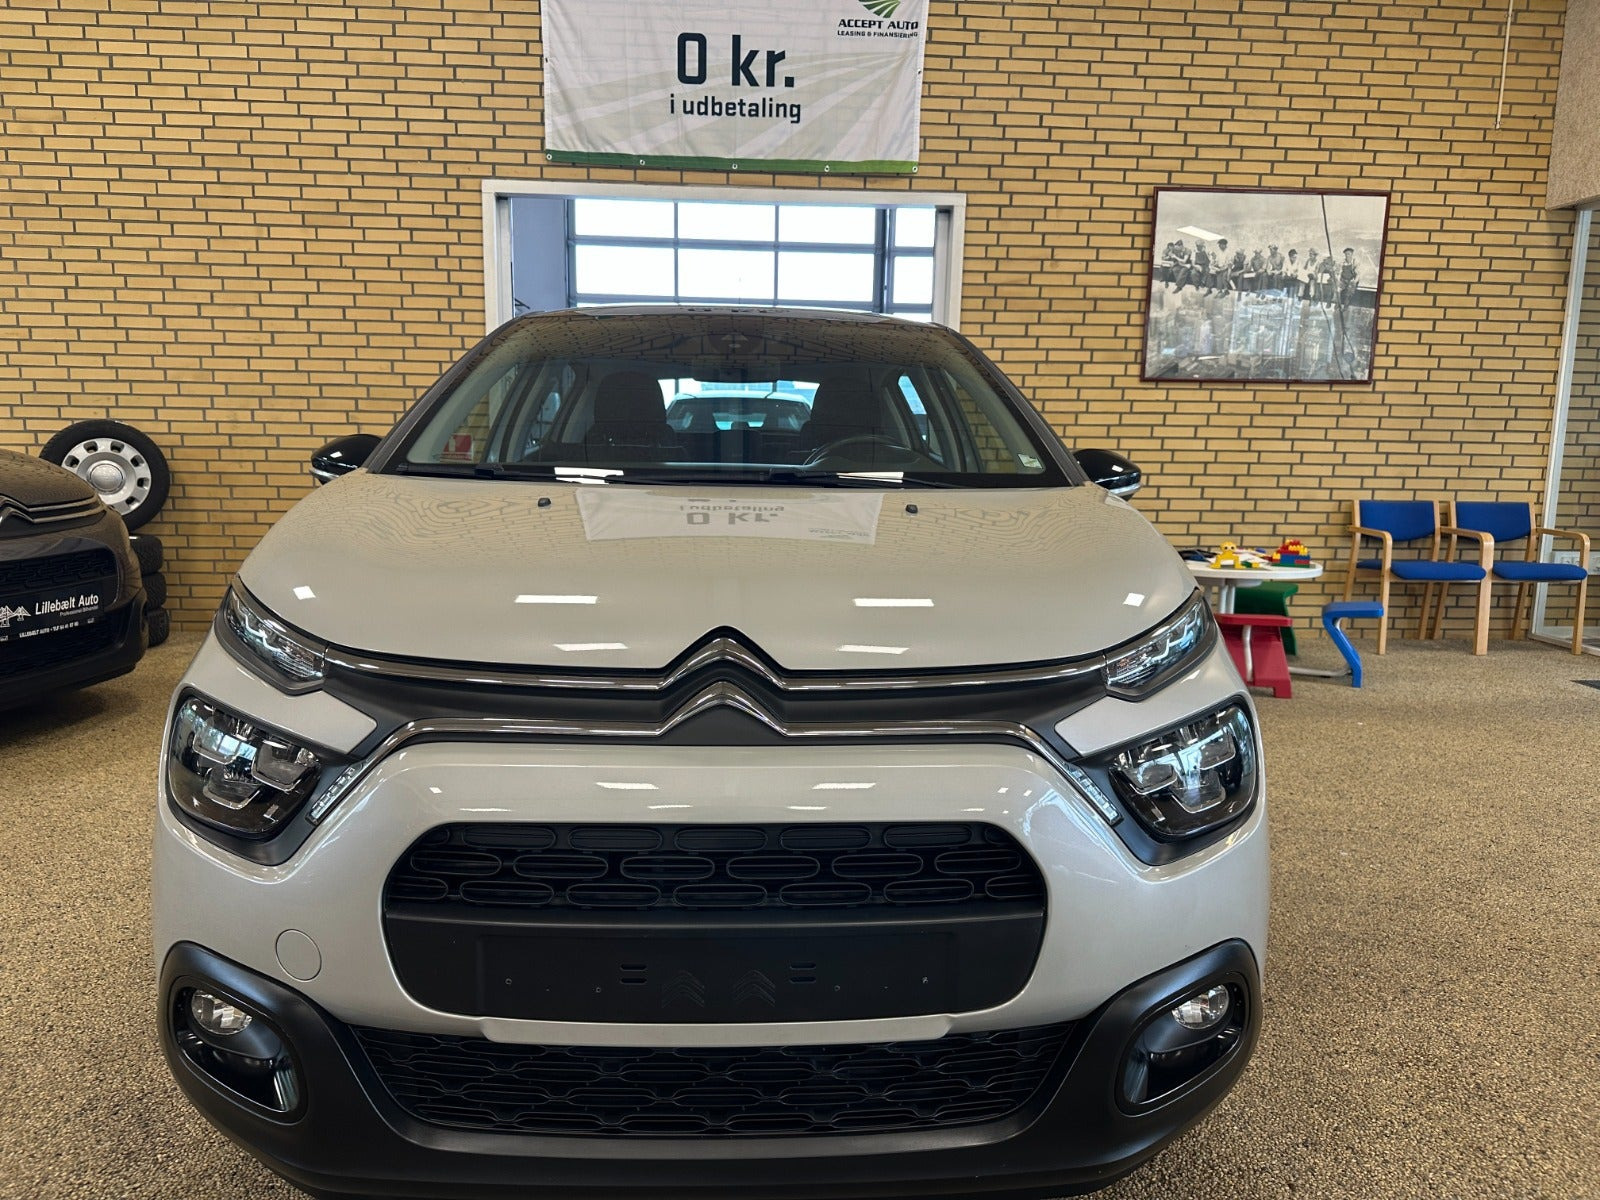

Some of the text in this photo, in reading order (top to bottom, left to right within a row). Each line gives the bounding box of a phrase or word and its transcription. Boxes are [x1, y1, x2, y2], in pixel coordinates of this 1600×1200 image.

[838, 19, 919, 30] ACCEPT AUTO
[873, 31, 918, 39] FINANSIERING
[731, 34, 795, 88] kr.
[670, 93, 801, 124] i udbetaling
[35, 596, 75, 616] Lillebælt
[78, 593, 99, 607] Auto
